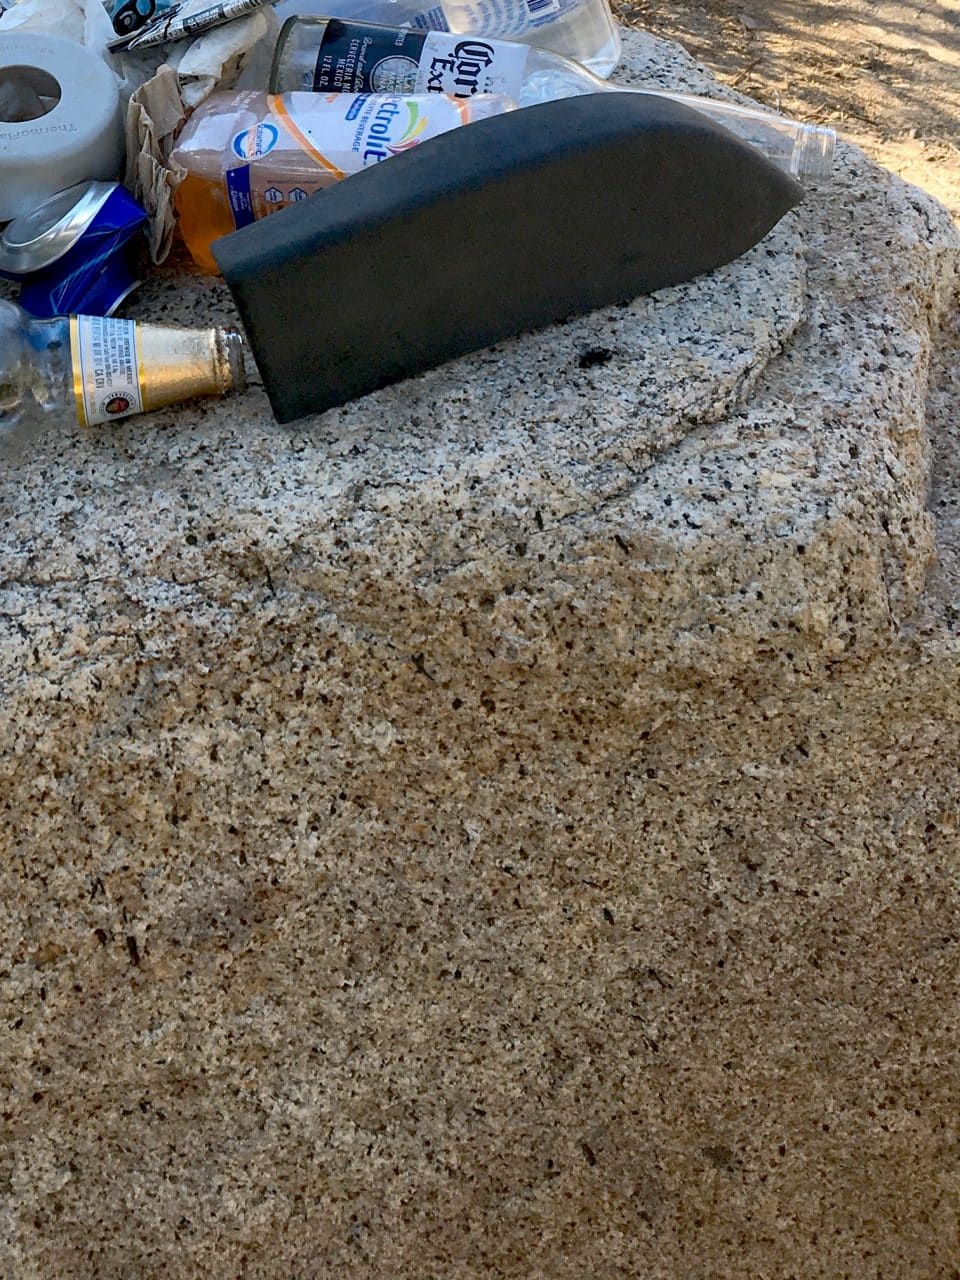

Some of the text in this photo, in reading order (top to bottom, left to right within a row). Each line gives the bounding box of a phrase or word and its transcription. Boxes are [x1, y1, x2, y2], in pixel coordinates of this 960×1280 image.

[334, 58, 345, 87] MEXICO
[344, 38, 359, 80] CERVECERIA
[427, 57, 454, 94] Ext
[449, 40, 495, 98] Cor
[352, 116, 368, 153] BEVERAGE
[363, 94, 400, 163] ctrolit
